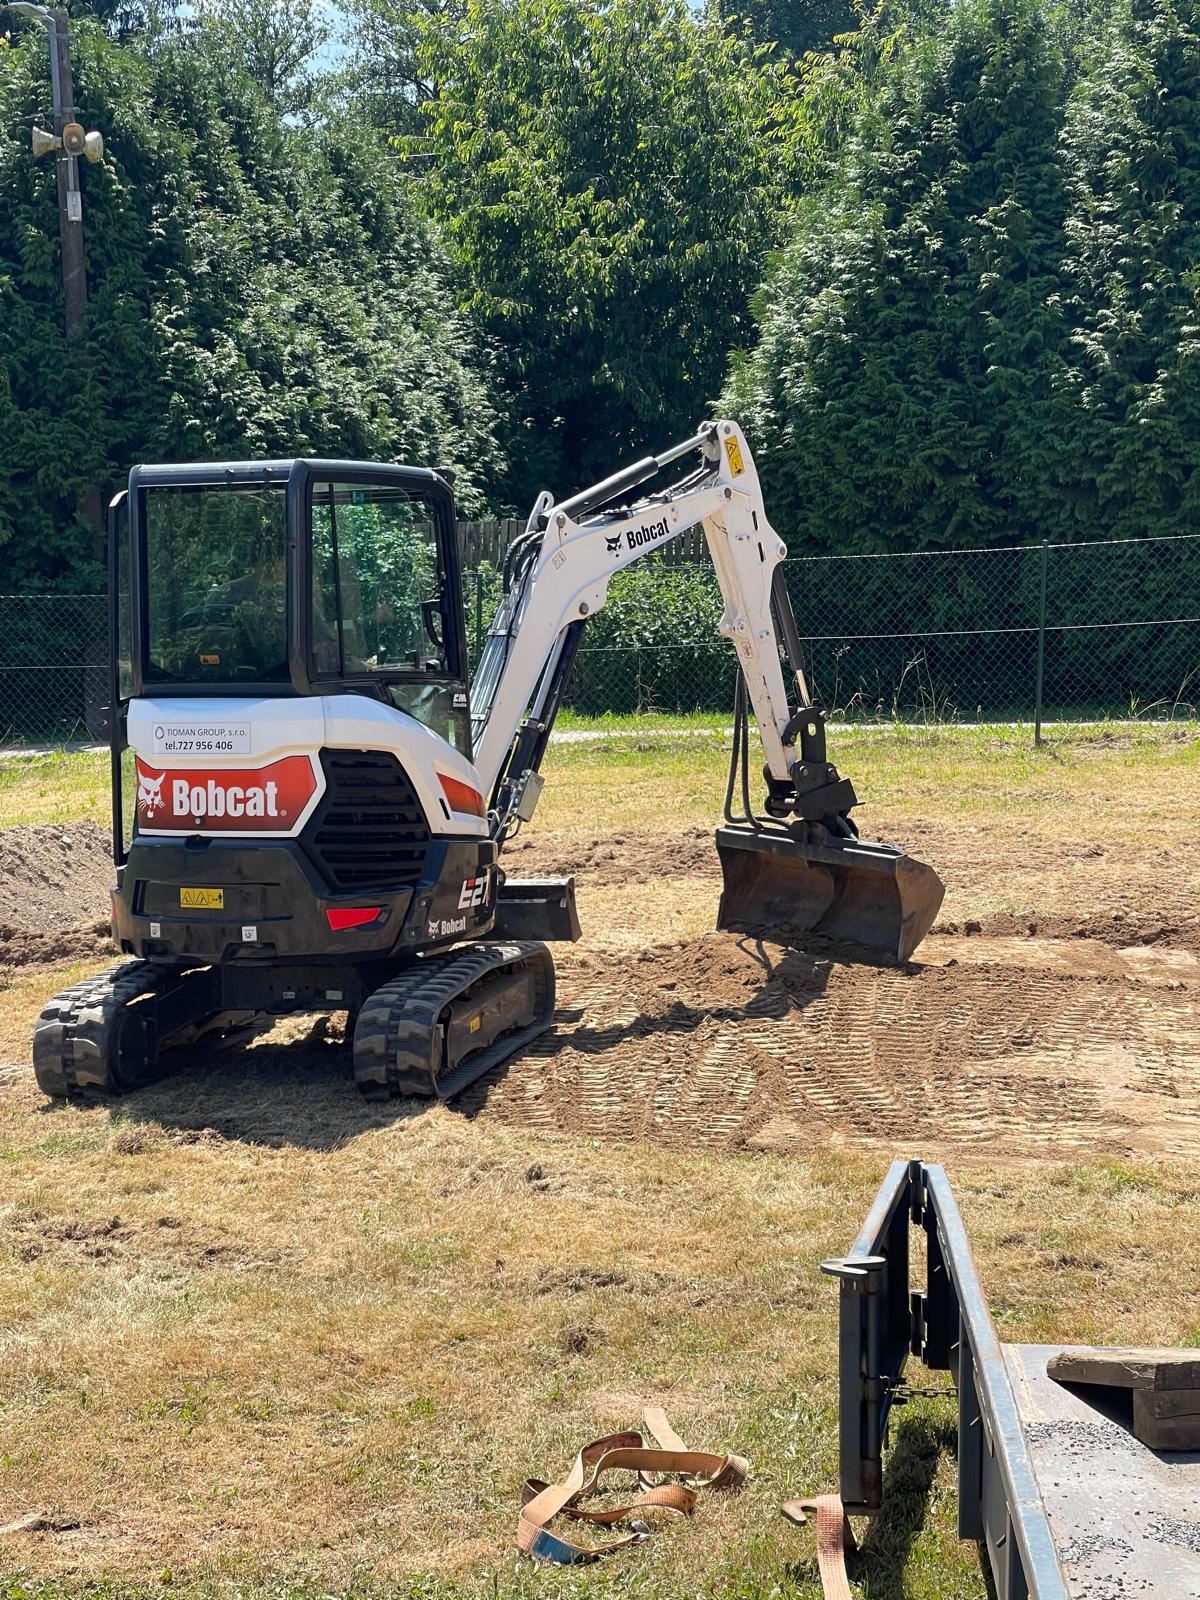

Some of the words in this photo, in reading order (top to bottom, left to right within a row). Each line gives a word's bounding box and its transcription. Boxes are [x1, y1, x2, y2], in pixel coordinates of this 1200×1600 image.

[626, 517, 670, 549] Bobcat
[167, 728, 196, 736] TIOMAN
[197, 728, 227, 737] GROUP,
[228, 729, 247, 737] s.r.o.
[165, 741, 194, 750] tel.727
[196, 741, 213, 750] 956
[215, 741, 233, 750] 406
[172, 779, 278, 817] Bobcat
[441, 916, 466, 935] Bobcat
